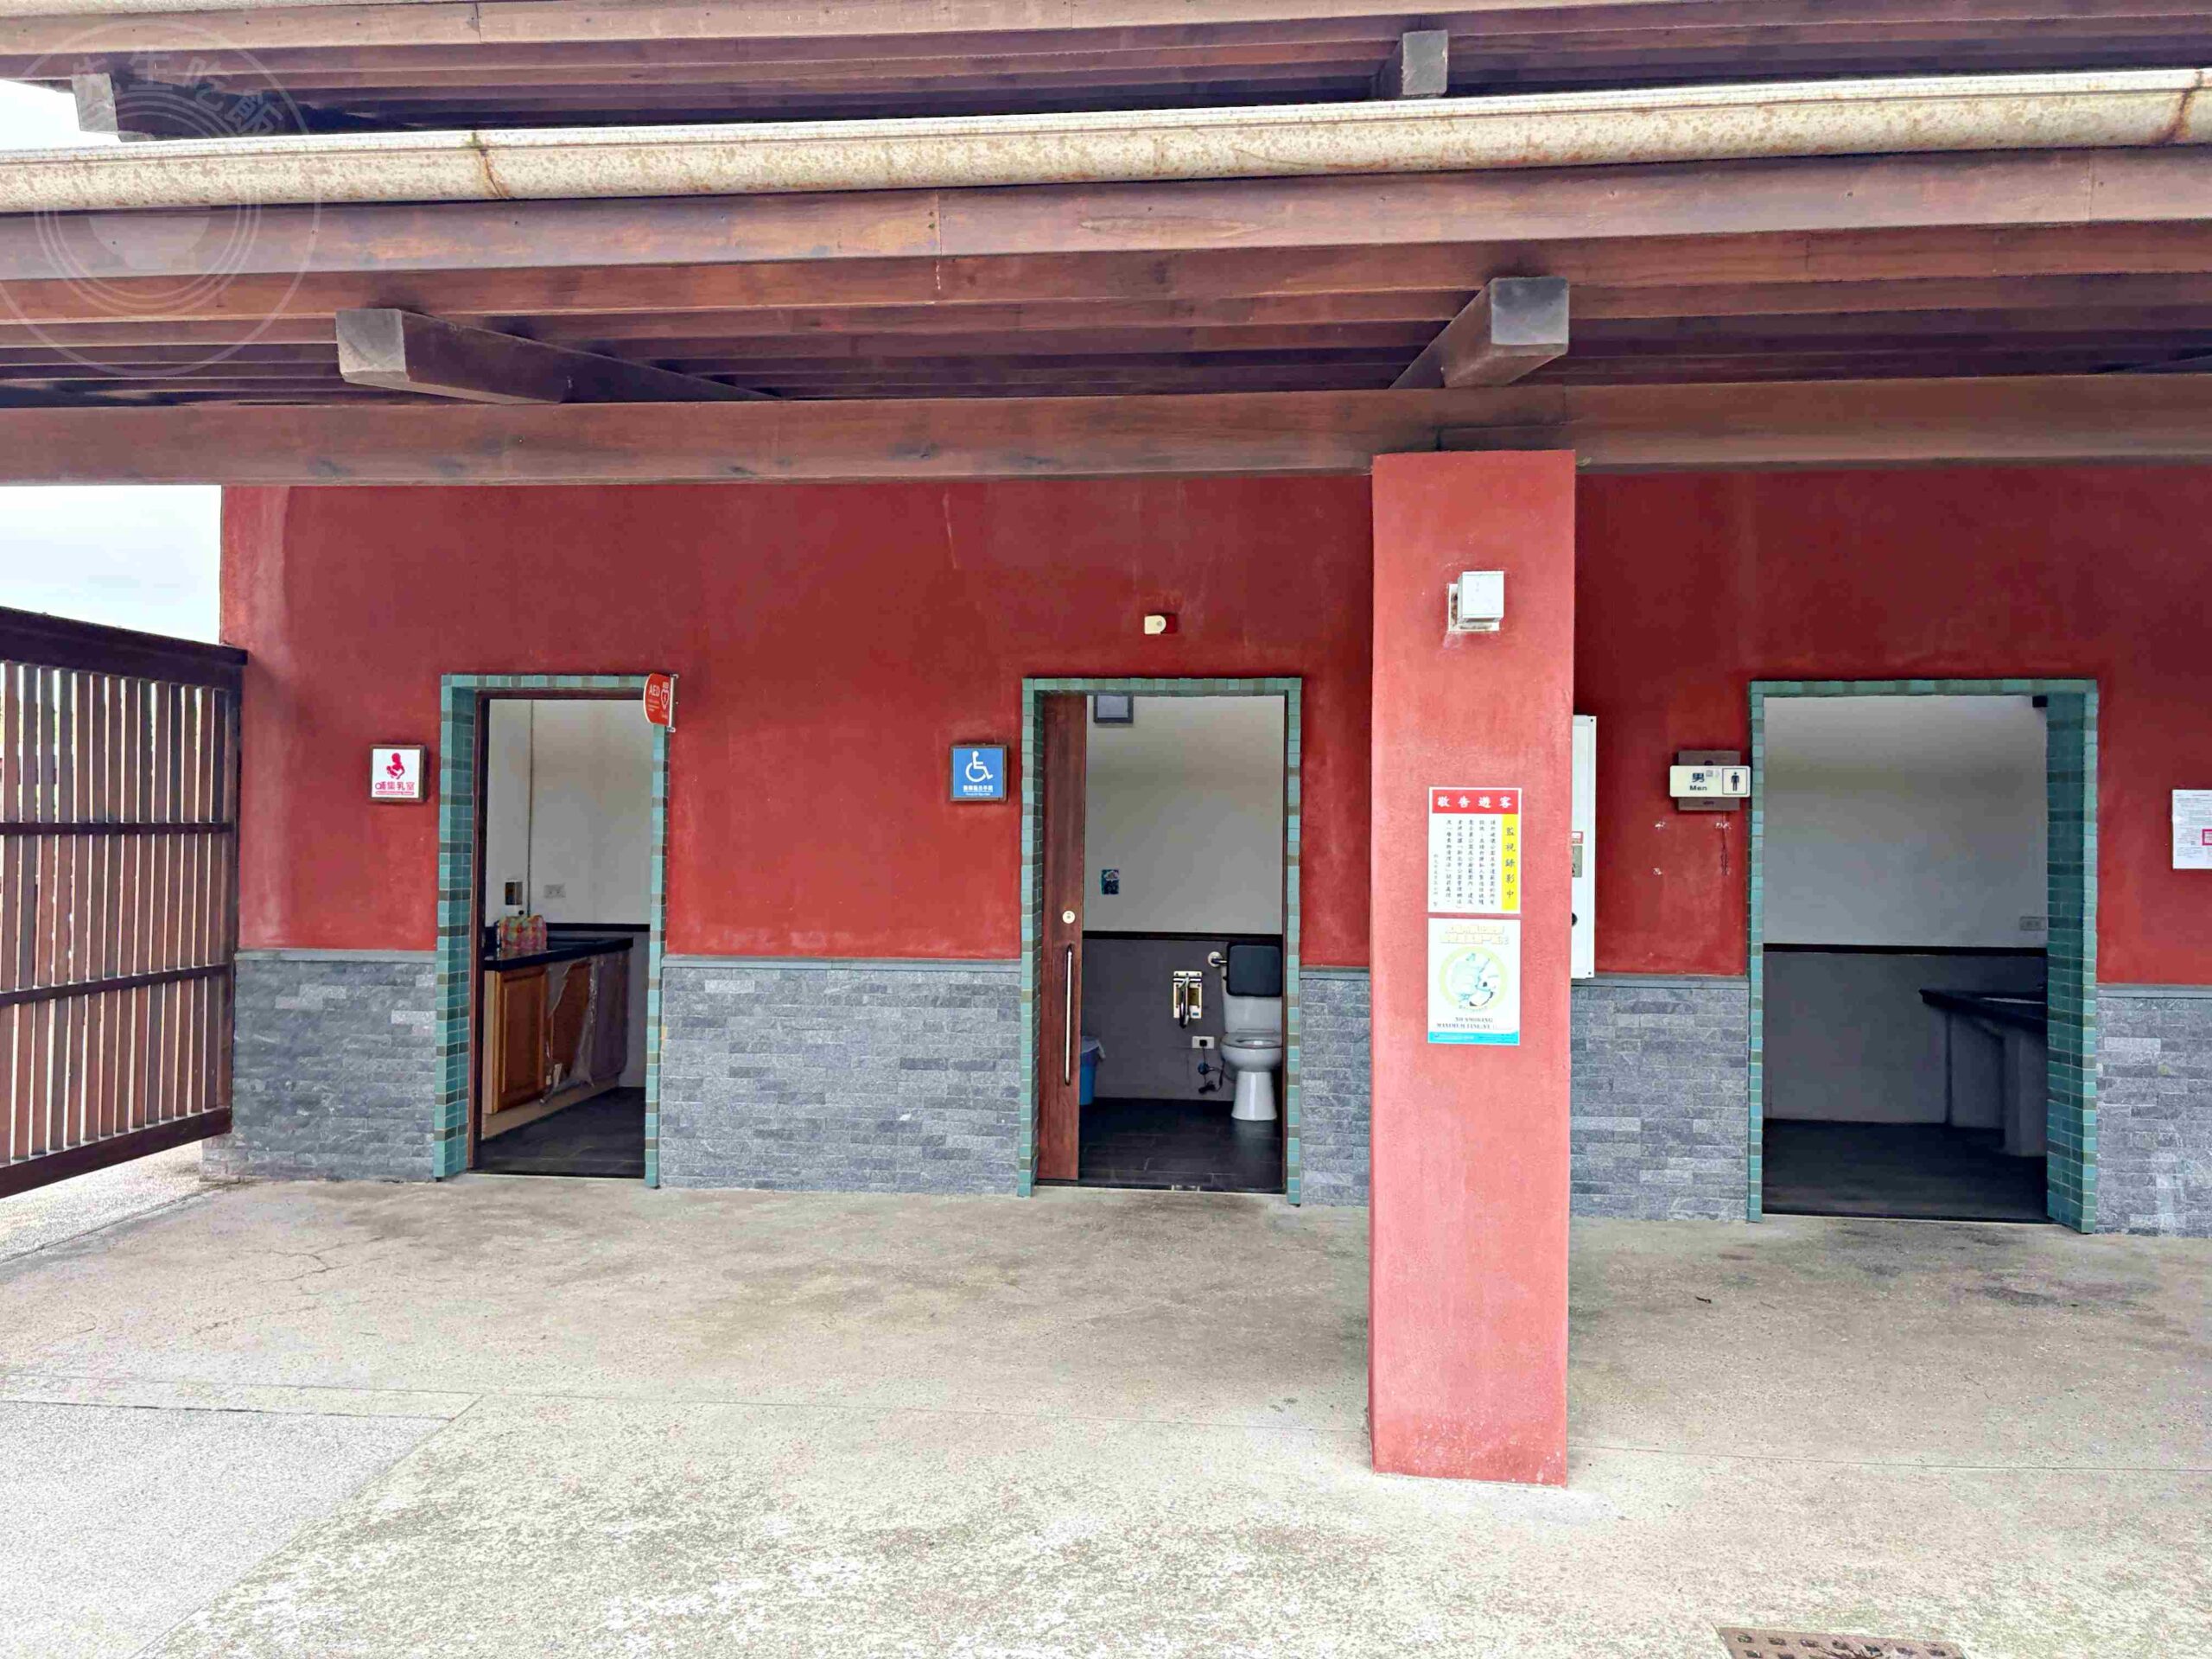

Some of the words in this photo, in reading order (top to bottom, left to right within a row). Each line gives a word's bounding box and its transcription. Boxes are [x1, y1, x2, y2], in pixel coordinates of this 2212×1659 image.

[649, 683, 660, 697] AED
[1692, 772, 1705, 783] 男
[1437, 795, 1513, 809] 敬告遊客
[1505, 826, 1516, 899] 監視錄影中
